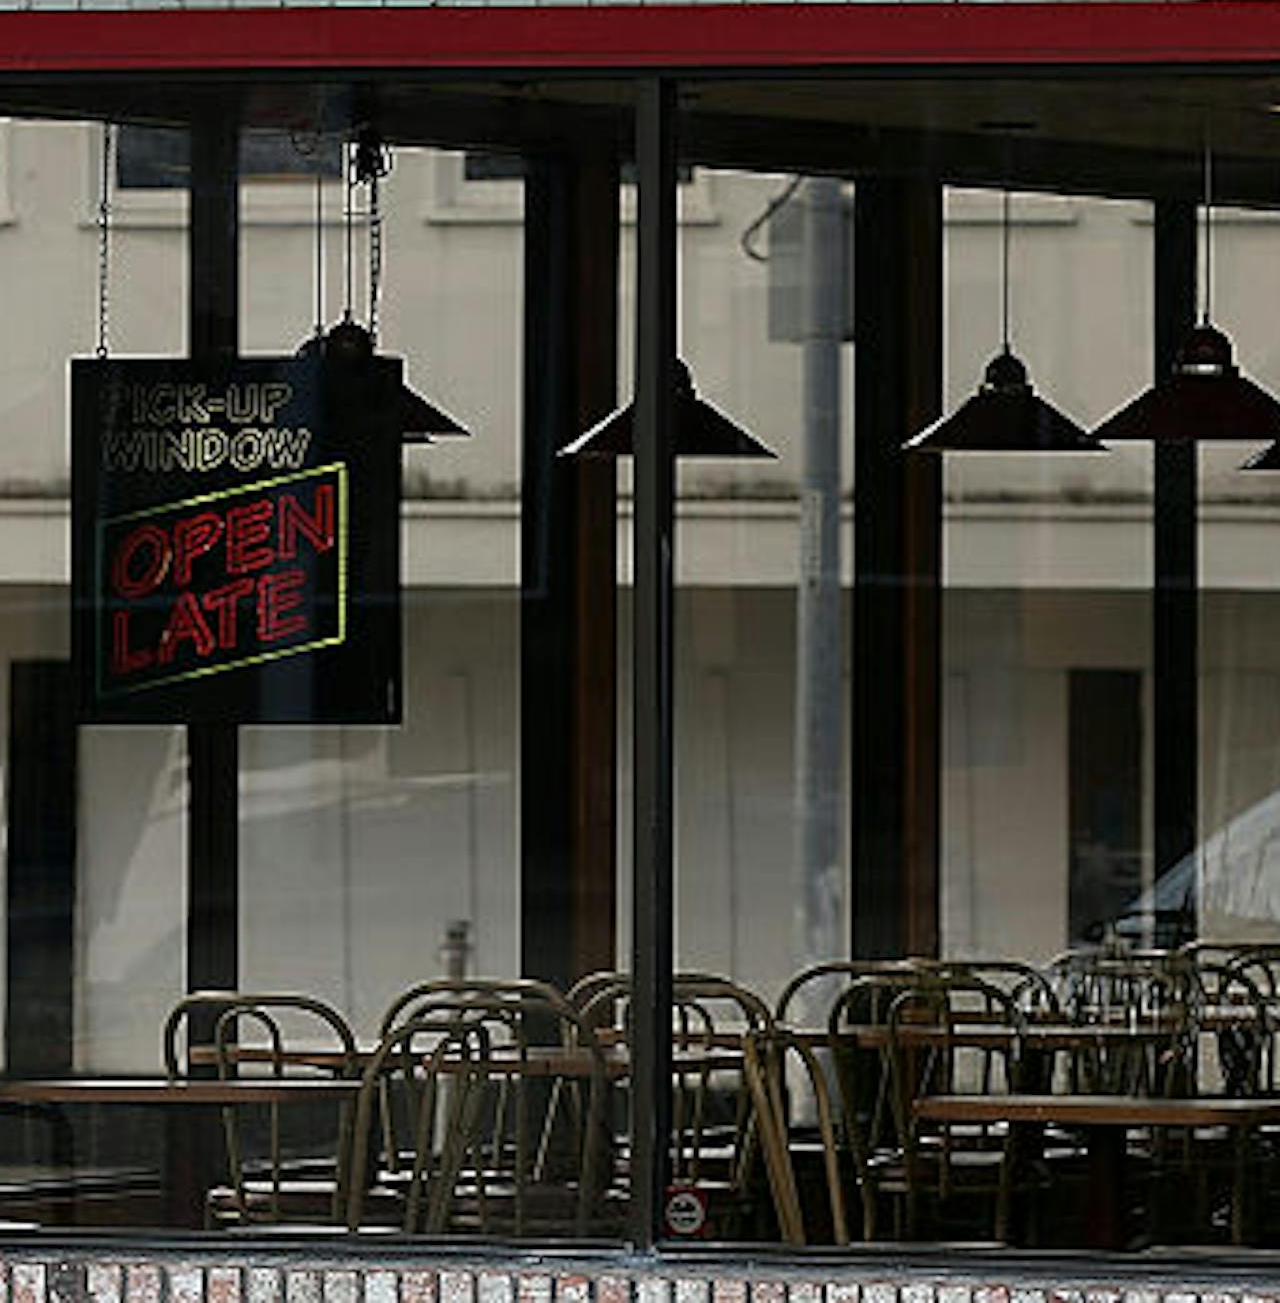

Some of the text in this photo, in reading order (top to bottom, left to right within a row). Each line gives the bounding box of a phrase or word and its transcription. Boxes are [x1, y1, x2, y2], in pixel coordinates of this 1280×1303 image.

[102, 384, 292, 425] PICK-UP
[102, 429, 312, 472] WINDOW
[113, 484, 334, 599] OPEN
[113, 569, 308, 673] LATE
